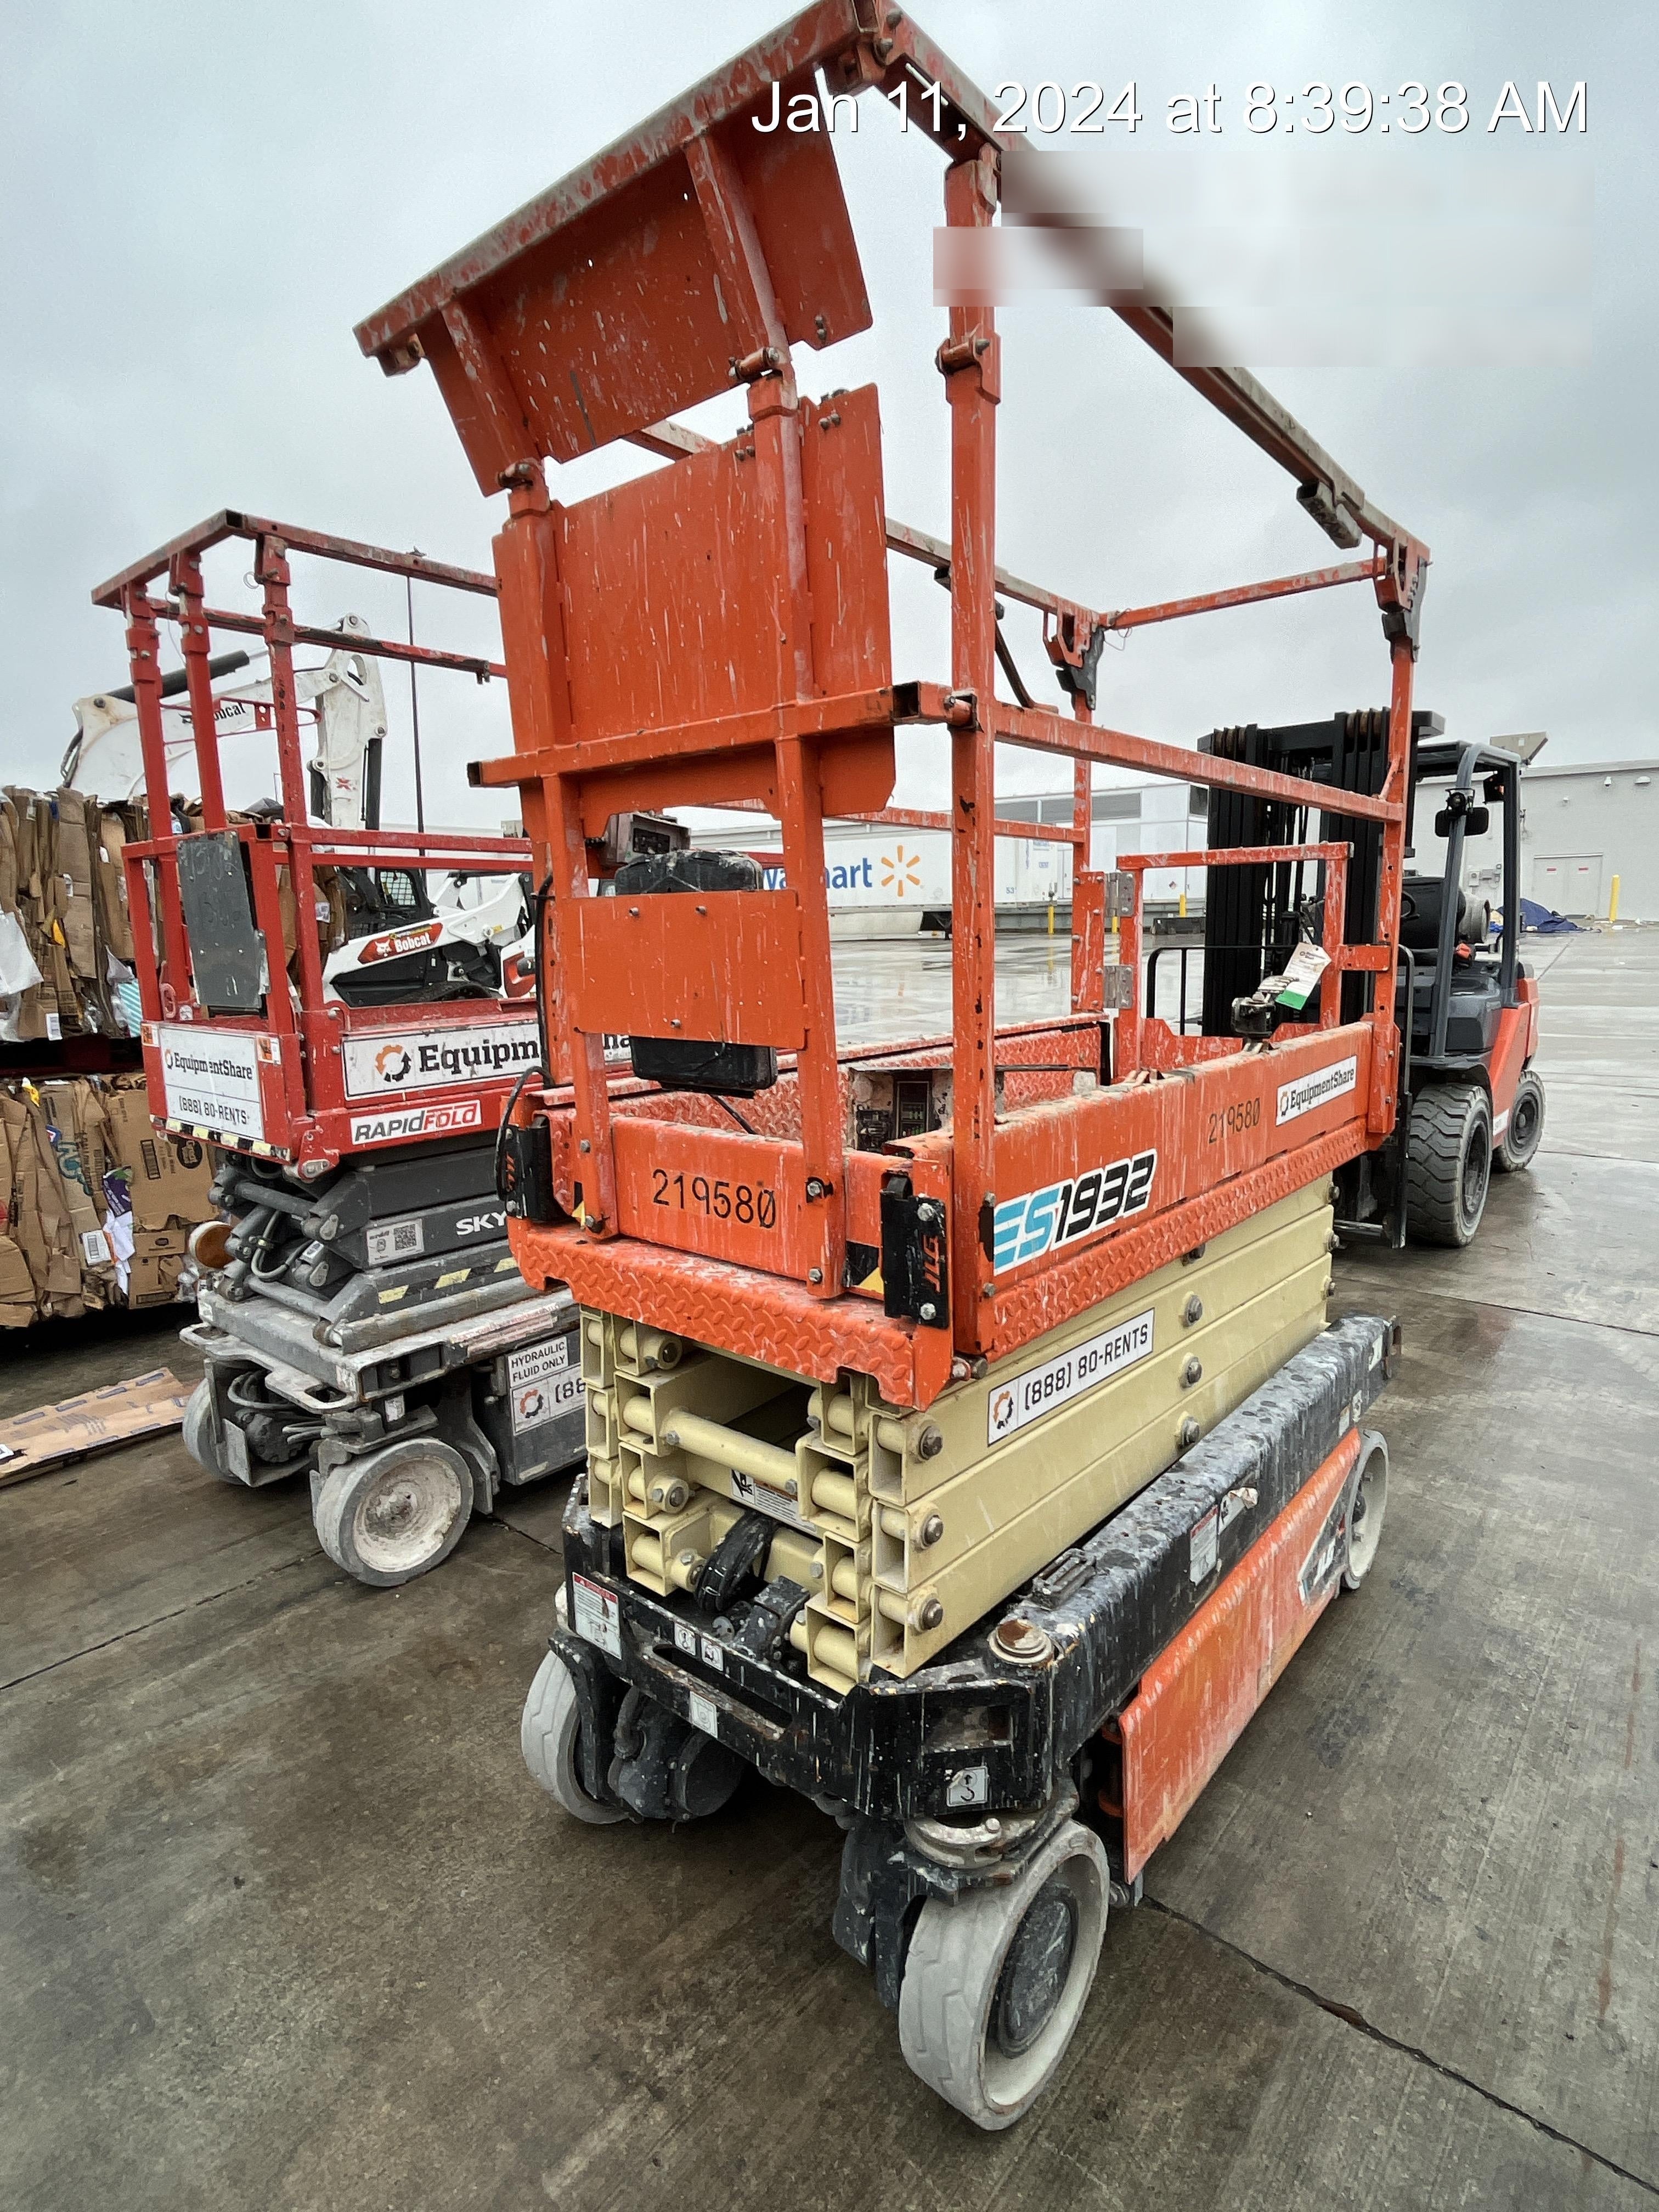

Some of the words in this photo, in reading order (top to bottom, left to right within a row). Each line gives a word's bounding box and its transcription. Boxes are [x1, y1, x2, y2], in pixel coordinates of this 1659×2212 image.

[213, 702, 246, 721] obcat
[394, 932, 431, 953] Bobcat
[174, 1053, 253, 1080] EquipmentShare
[1290, 1068, 1355, 1110] EquipmentShare
[204, 1102, 247, 1125] 80-RENTS
[1209, 1097, 1261, 1144] 219580
[652, 1169, 776, 1228] 219580
[994, 1152, 1155, 1270] ES1932
[456, 1211, 507, 1235] SKY
[922, 1234, 940, 1293] JLG
[511, 1342, 565, 1368] HYDRAULIC
[512, 1365, 540, 1382] FLUID
[541, 1355, 566, 1371] ONLY
[1025, 1362, 1071, 1410] (888)
[1078, 1323, 1148, 1379] 80-RENTS
